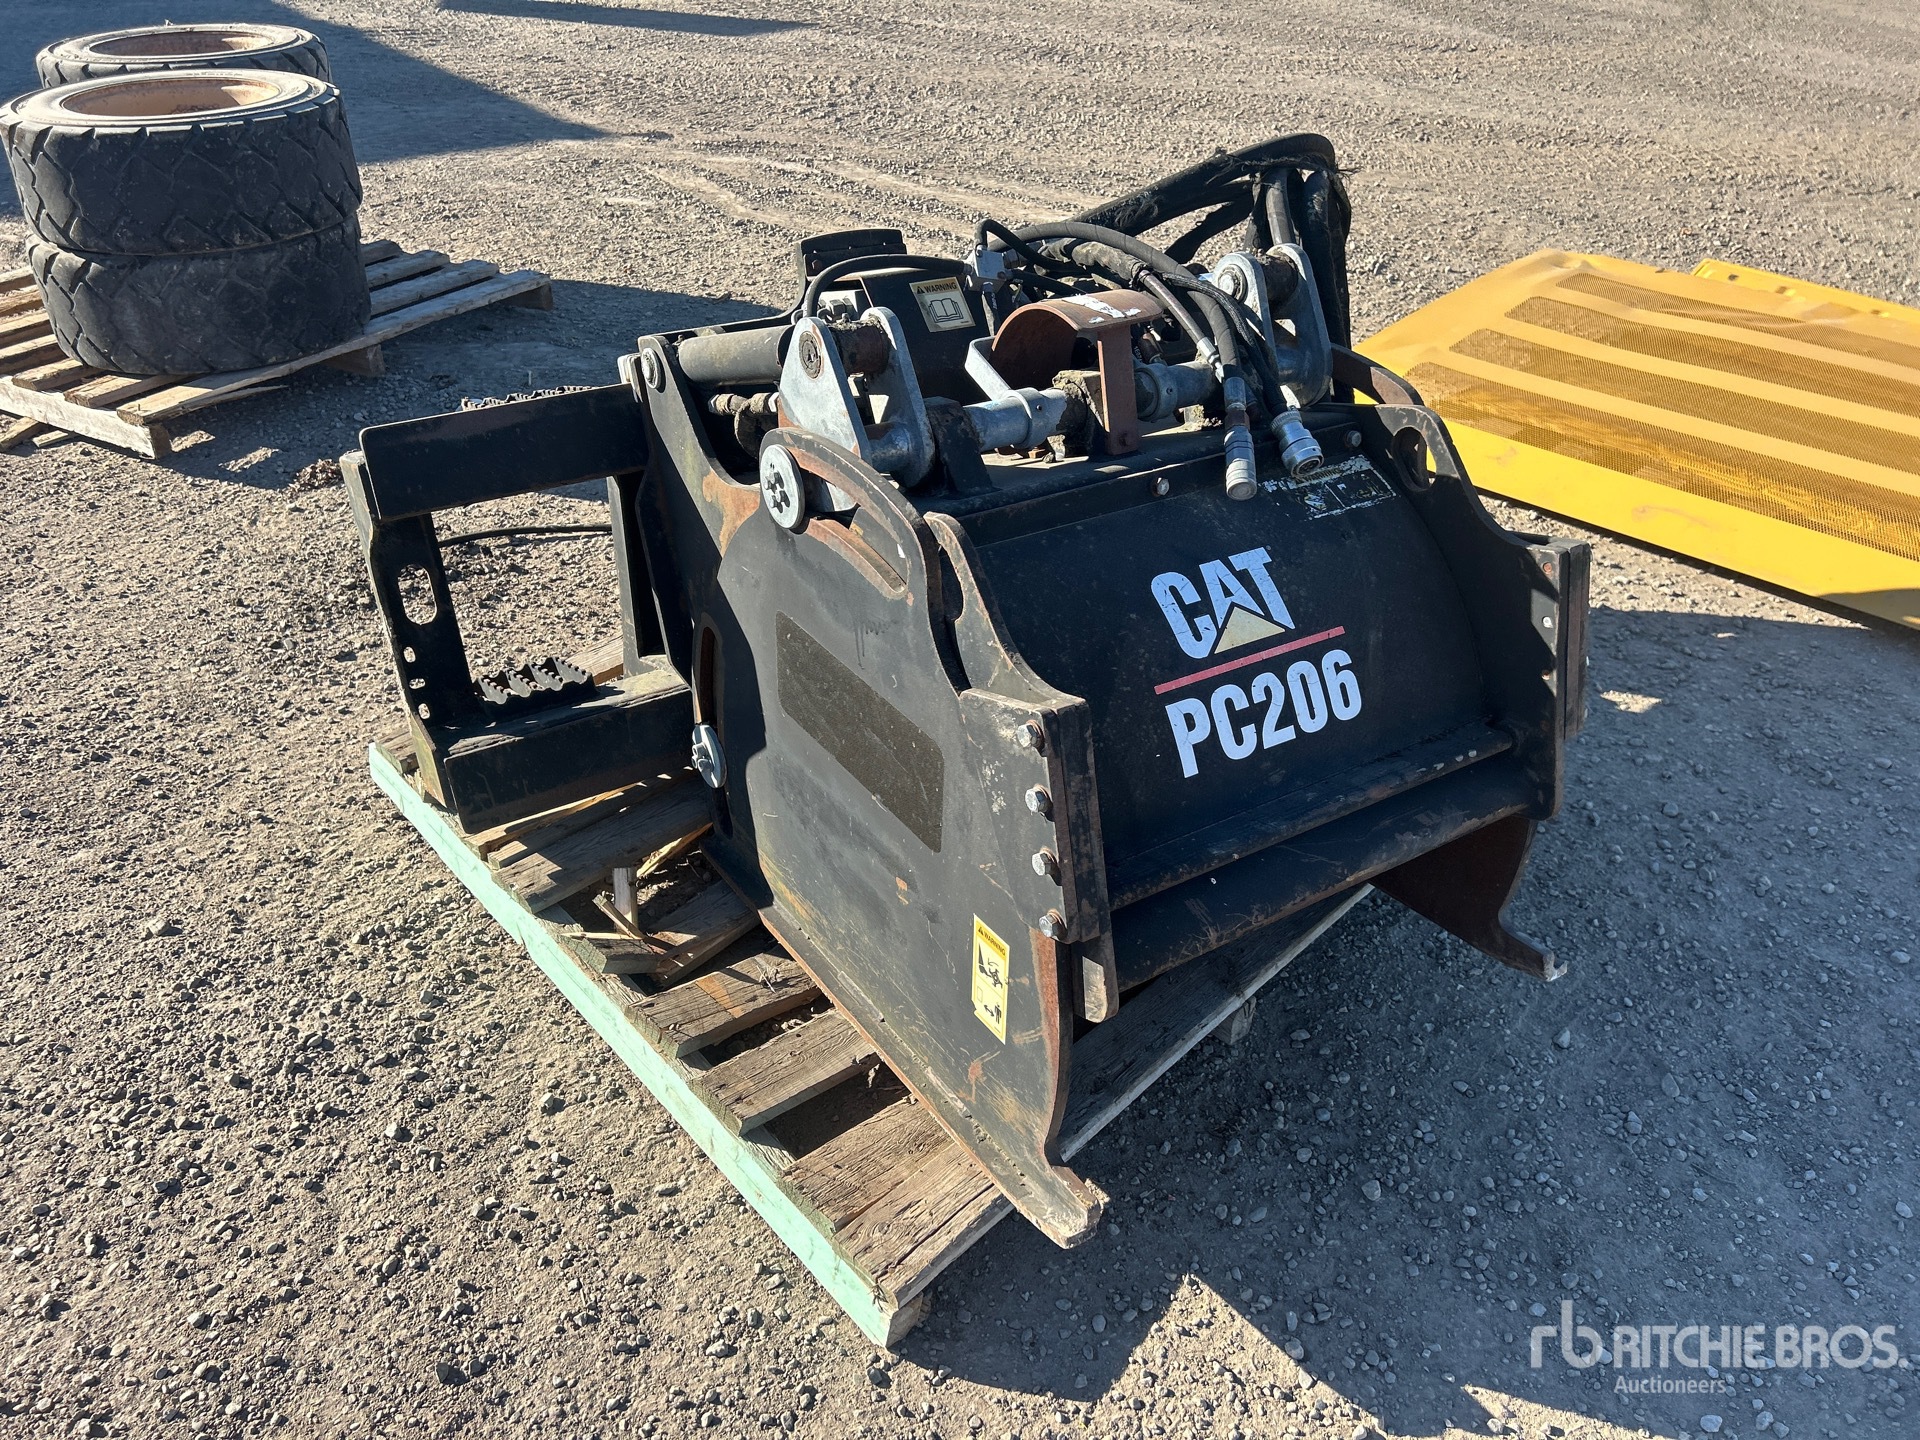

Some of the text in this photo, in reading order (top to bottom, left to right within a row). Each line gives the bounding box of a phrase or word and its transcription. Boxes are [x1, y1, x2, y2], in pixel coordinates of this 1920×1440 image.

[924, 282, 957, 293] WARNING
[1151, 547, 1296, 659] CAT
[1165, 649, 1362, 779] PC206
